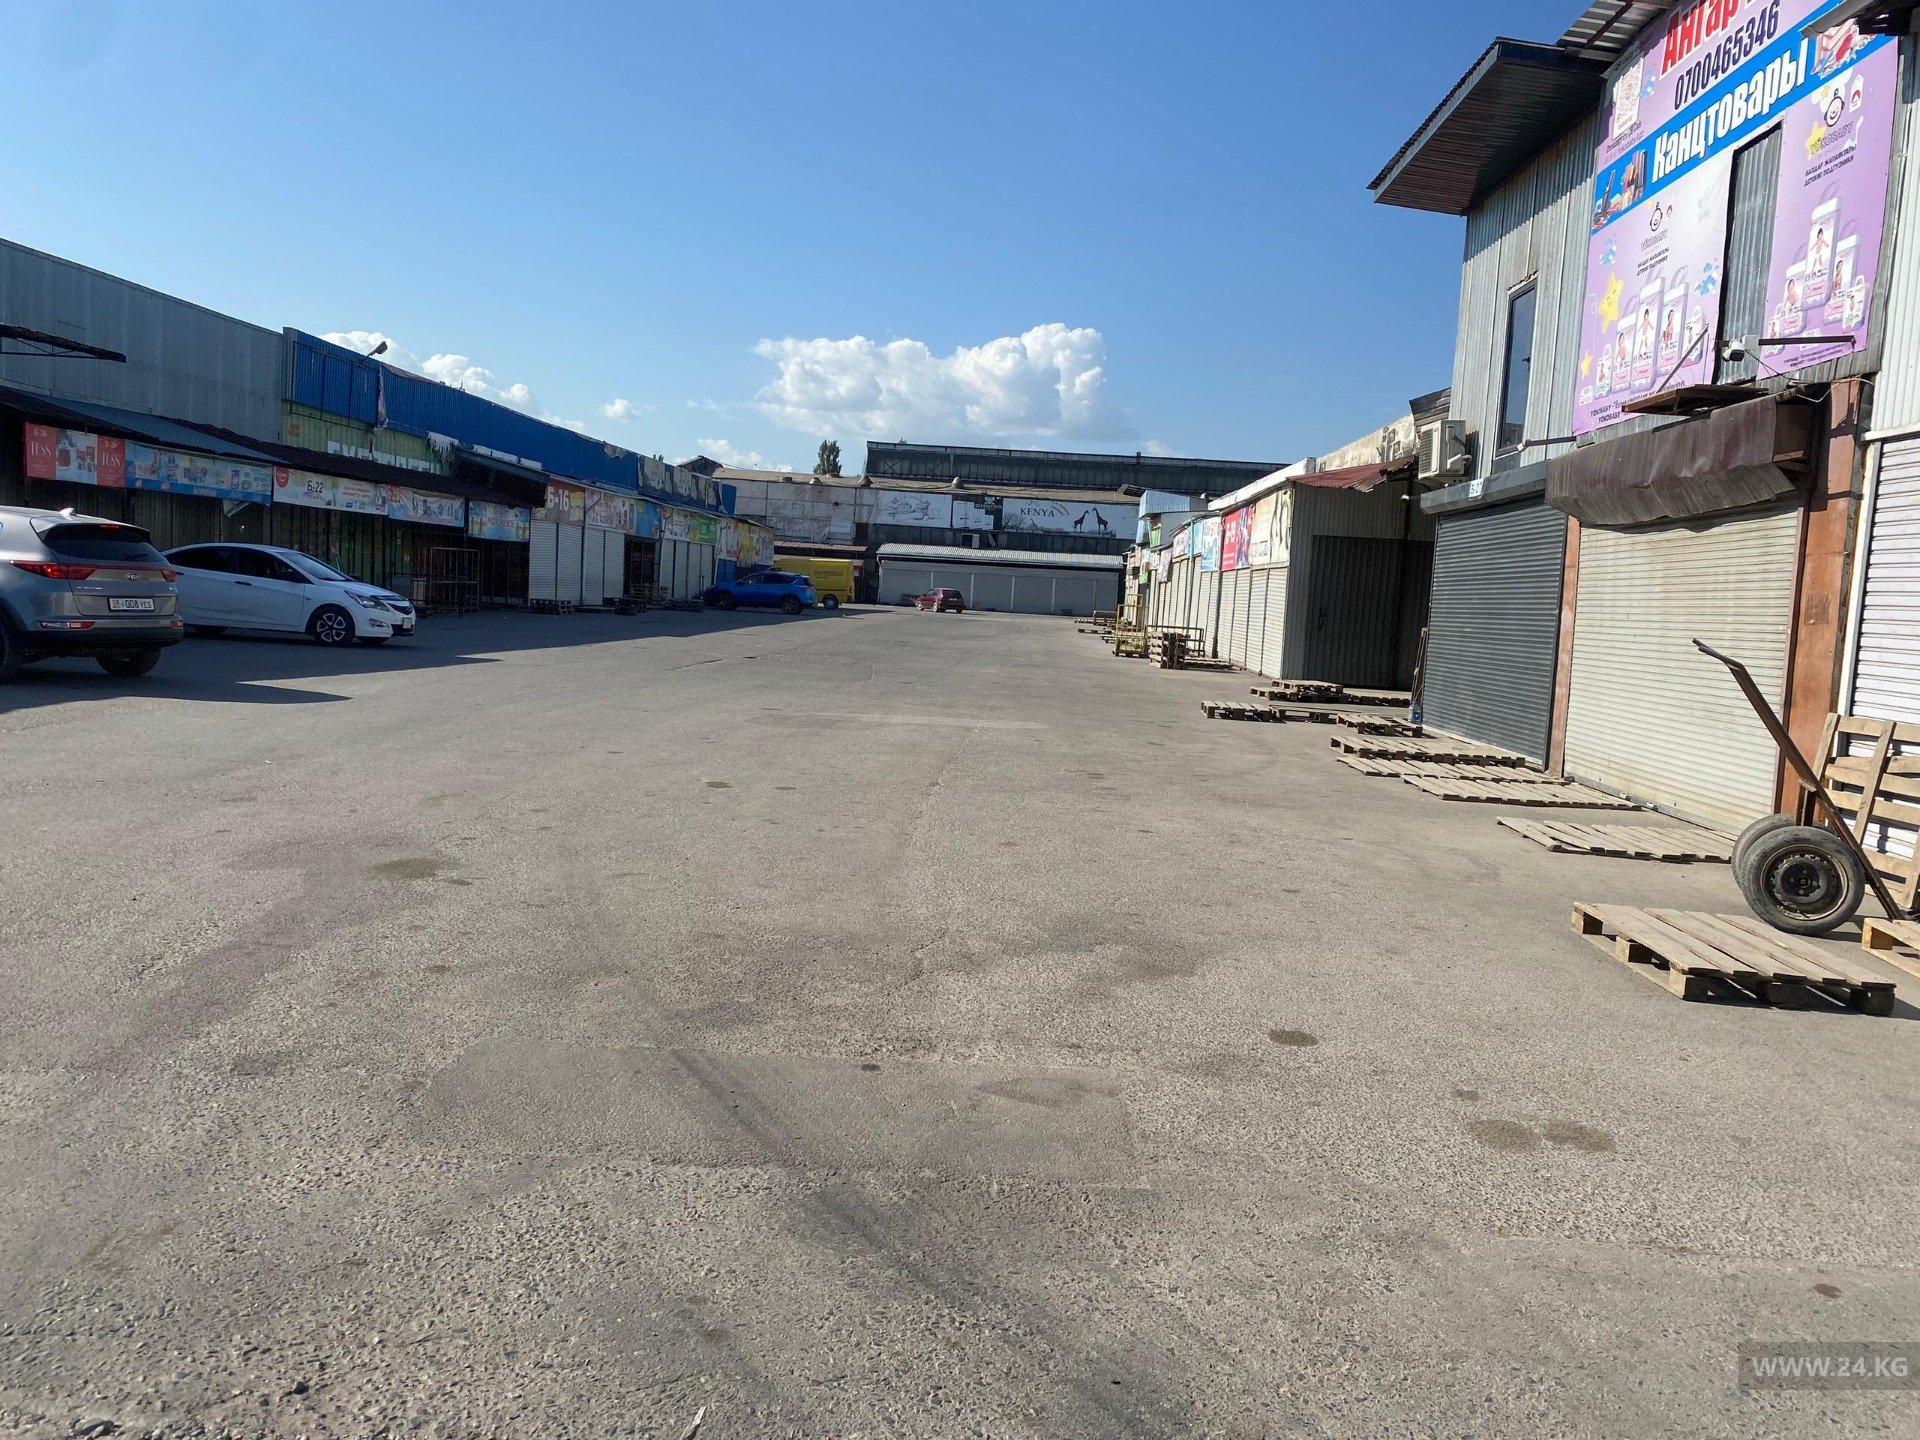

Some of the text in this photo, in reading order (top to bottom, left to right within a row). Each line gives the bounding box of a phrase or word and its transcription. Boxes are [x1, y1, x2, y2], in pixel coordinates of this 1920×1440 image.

[1651, 38, 1809, 184] Канцтовары
[1674, 0, 1780, 111] 0700465346
[1020, 507, 1055, 518] KENYA
